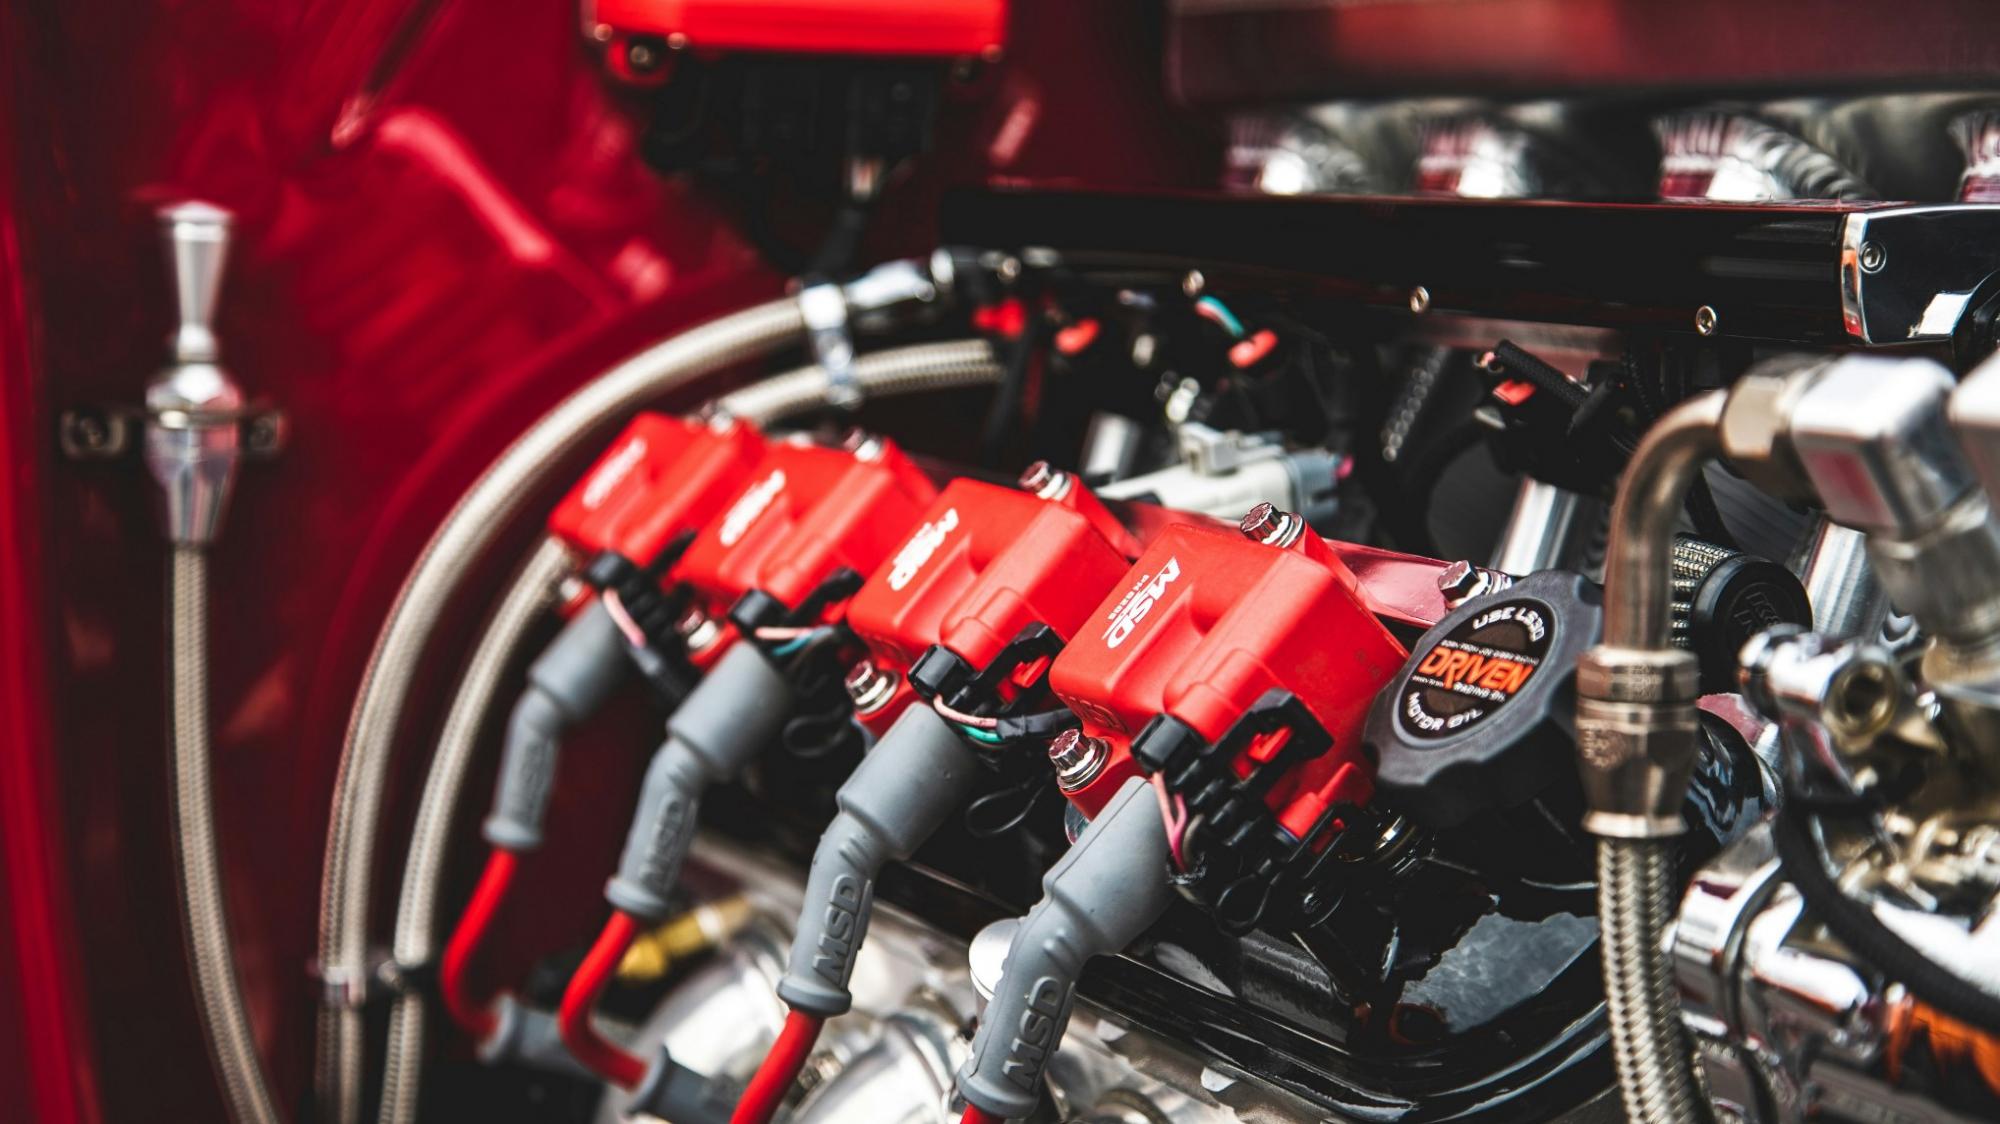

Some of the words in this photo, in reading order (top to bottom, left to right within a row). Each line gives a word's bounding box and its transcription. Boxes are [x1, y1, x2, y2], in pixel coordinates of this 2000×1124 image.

[1105, 556, 1181, 649] MSD
[1472, 606, 1516, 630] USE
[1514, 607, 1545, 642] LS30
[1417, 645, 1534, 695] DRIVEN
[1452, 681, 1491, 698] RACING
[1407, 691, 1445, 731] MOTOR
[1447, 708, 1484, 730] OIL
[812, 874, 861, 985] MSD
[1001, 977, 1062, 1091] MSD
